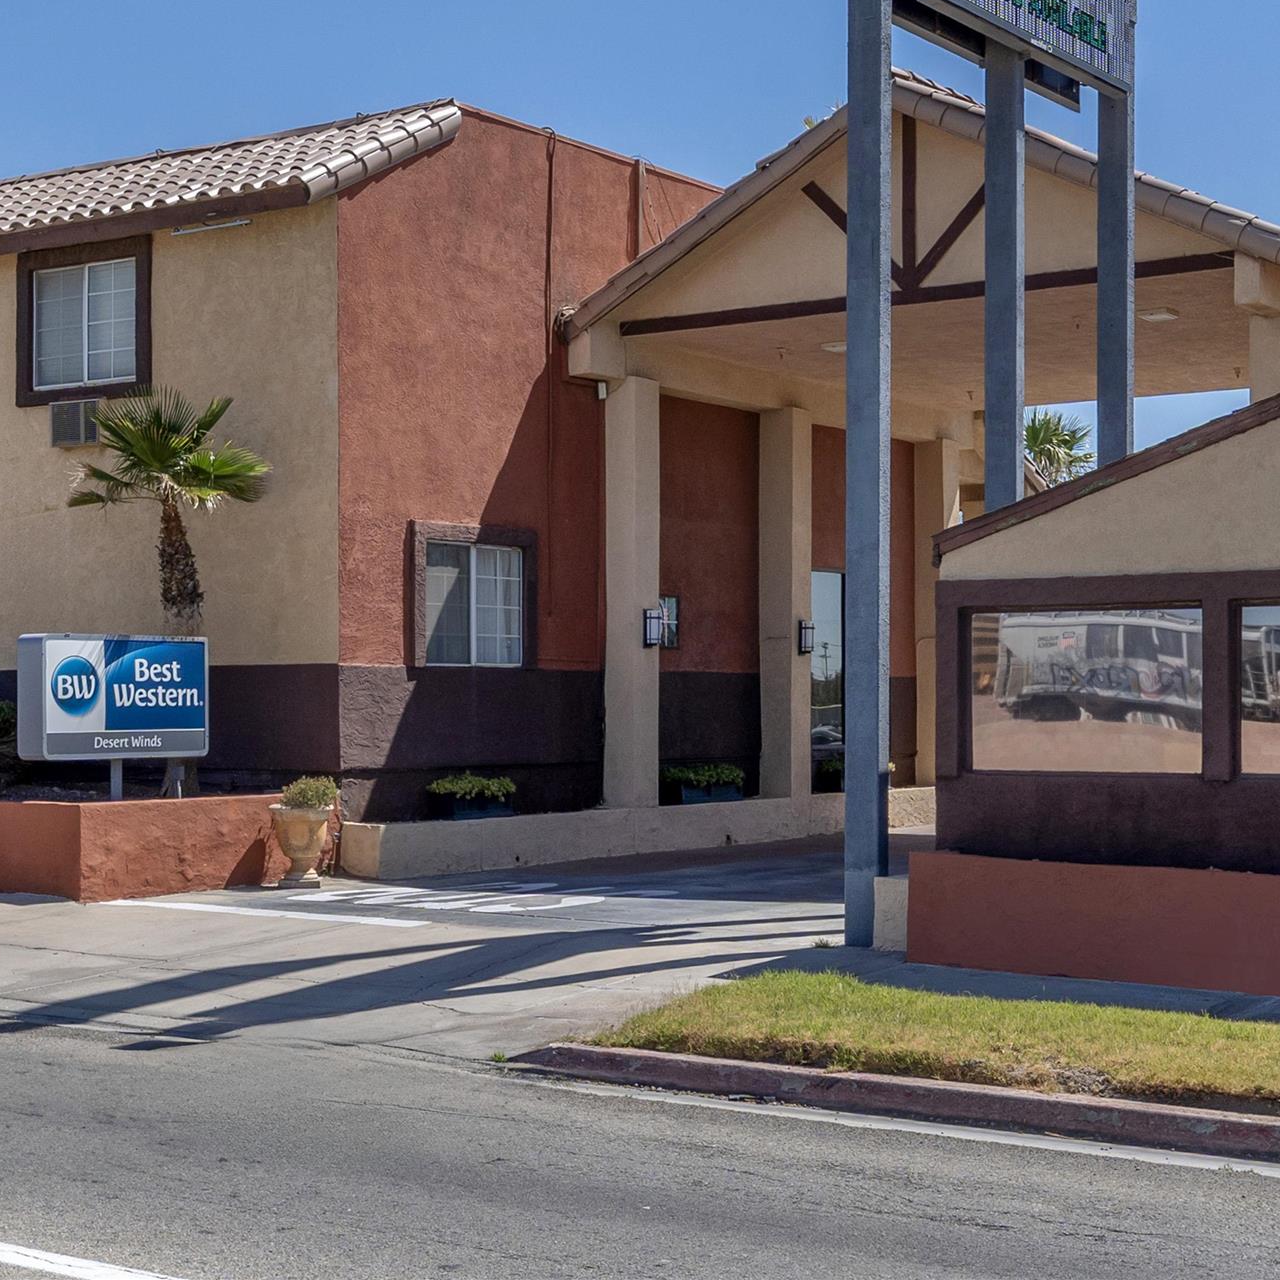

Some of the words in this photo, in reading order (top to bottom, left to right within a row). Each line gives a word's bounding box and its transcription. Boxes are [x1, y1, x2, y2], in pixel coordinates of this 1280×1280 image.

[134, 658, 181, 682] Best
[57, 674, 95, 700] BW
[94, 736, 129, 749] Desert
[132, 735, 162, 748] Winds
